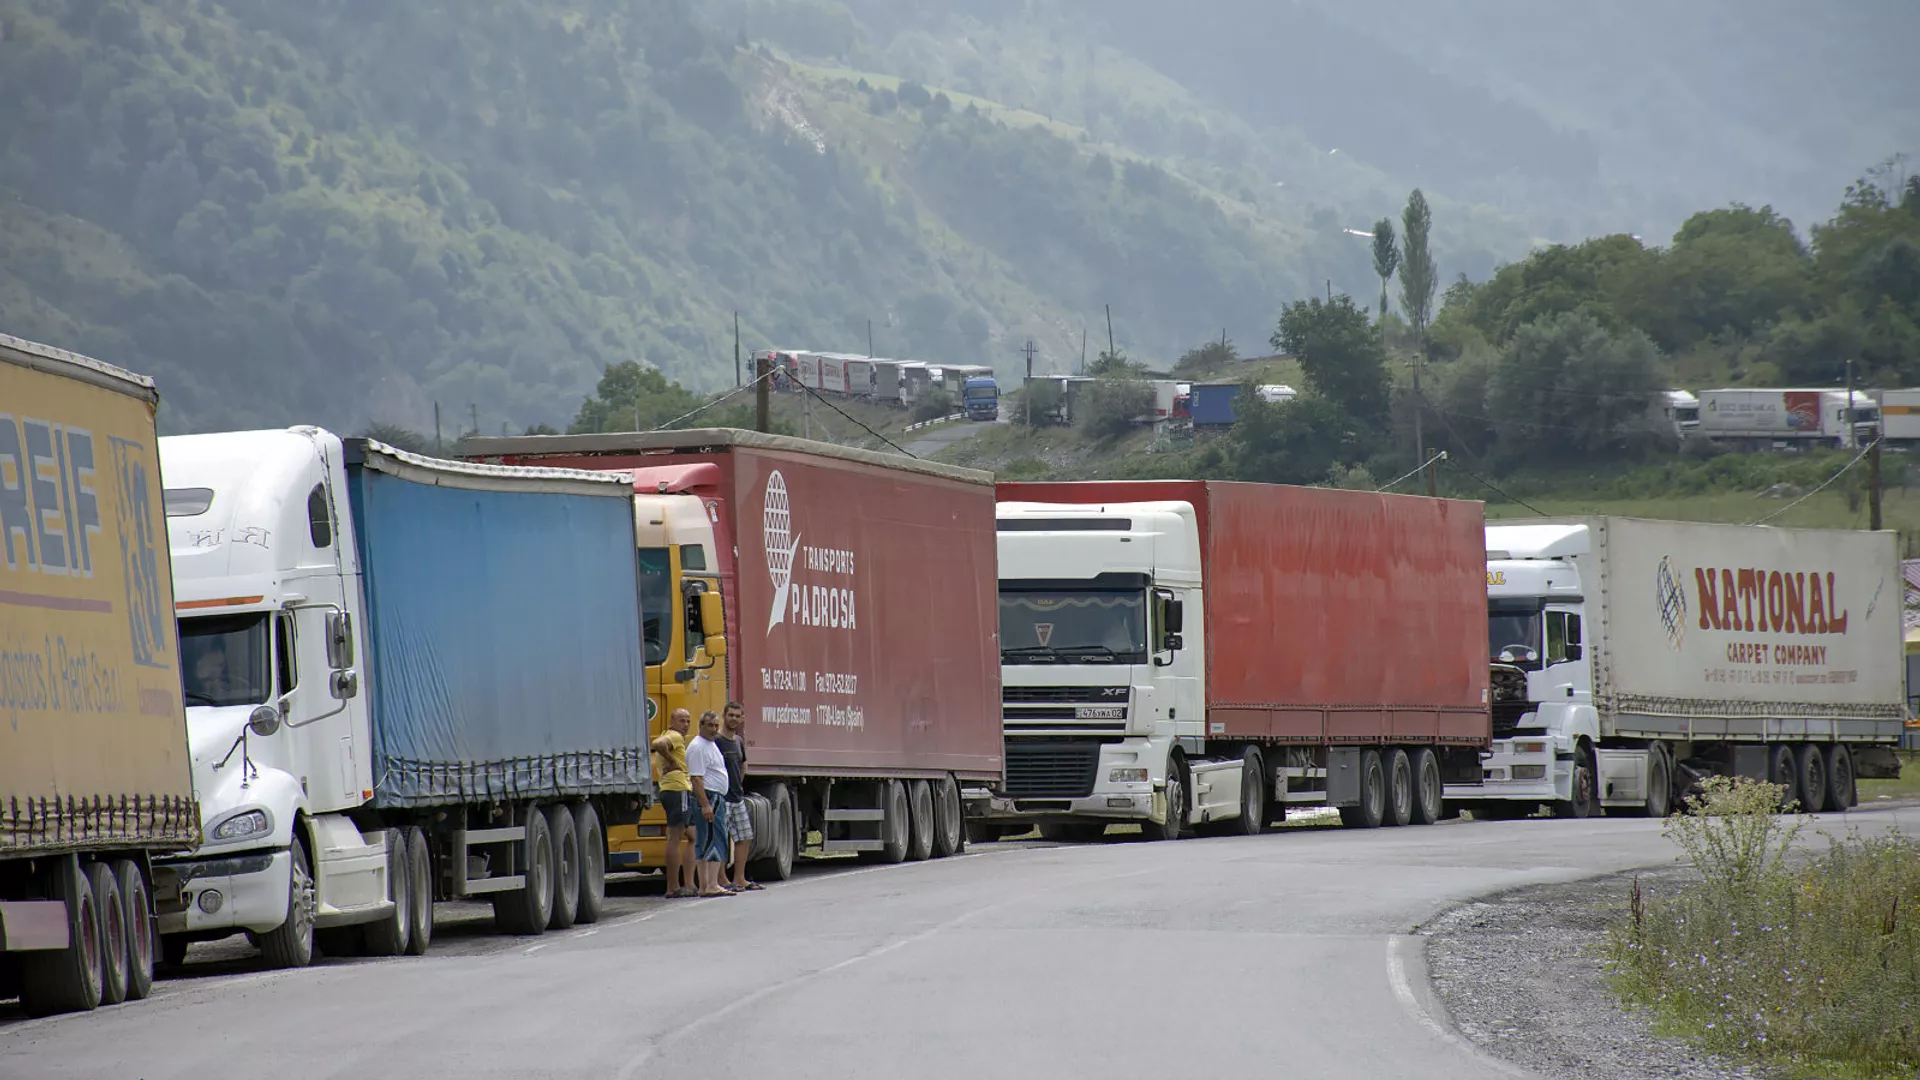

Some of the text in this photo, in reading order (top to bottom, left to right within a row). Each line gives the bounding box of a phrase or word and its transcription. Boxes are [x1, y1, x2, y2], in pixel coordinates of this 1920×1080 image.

[803, 546, 854, 575] TRANSPORTS
[791, 583, 856, 630] PADROSA
[1694, 567, 1848, 635] NATIONAL
[1727, 643, 1828, 666] CARPET COMPANY
[57, 635, 93, 713] Rent
[1101, 688, 1128, 696] XF
